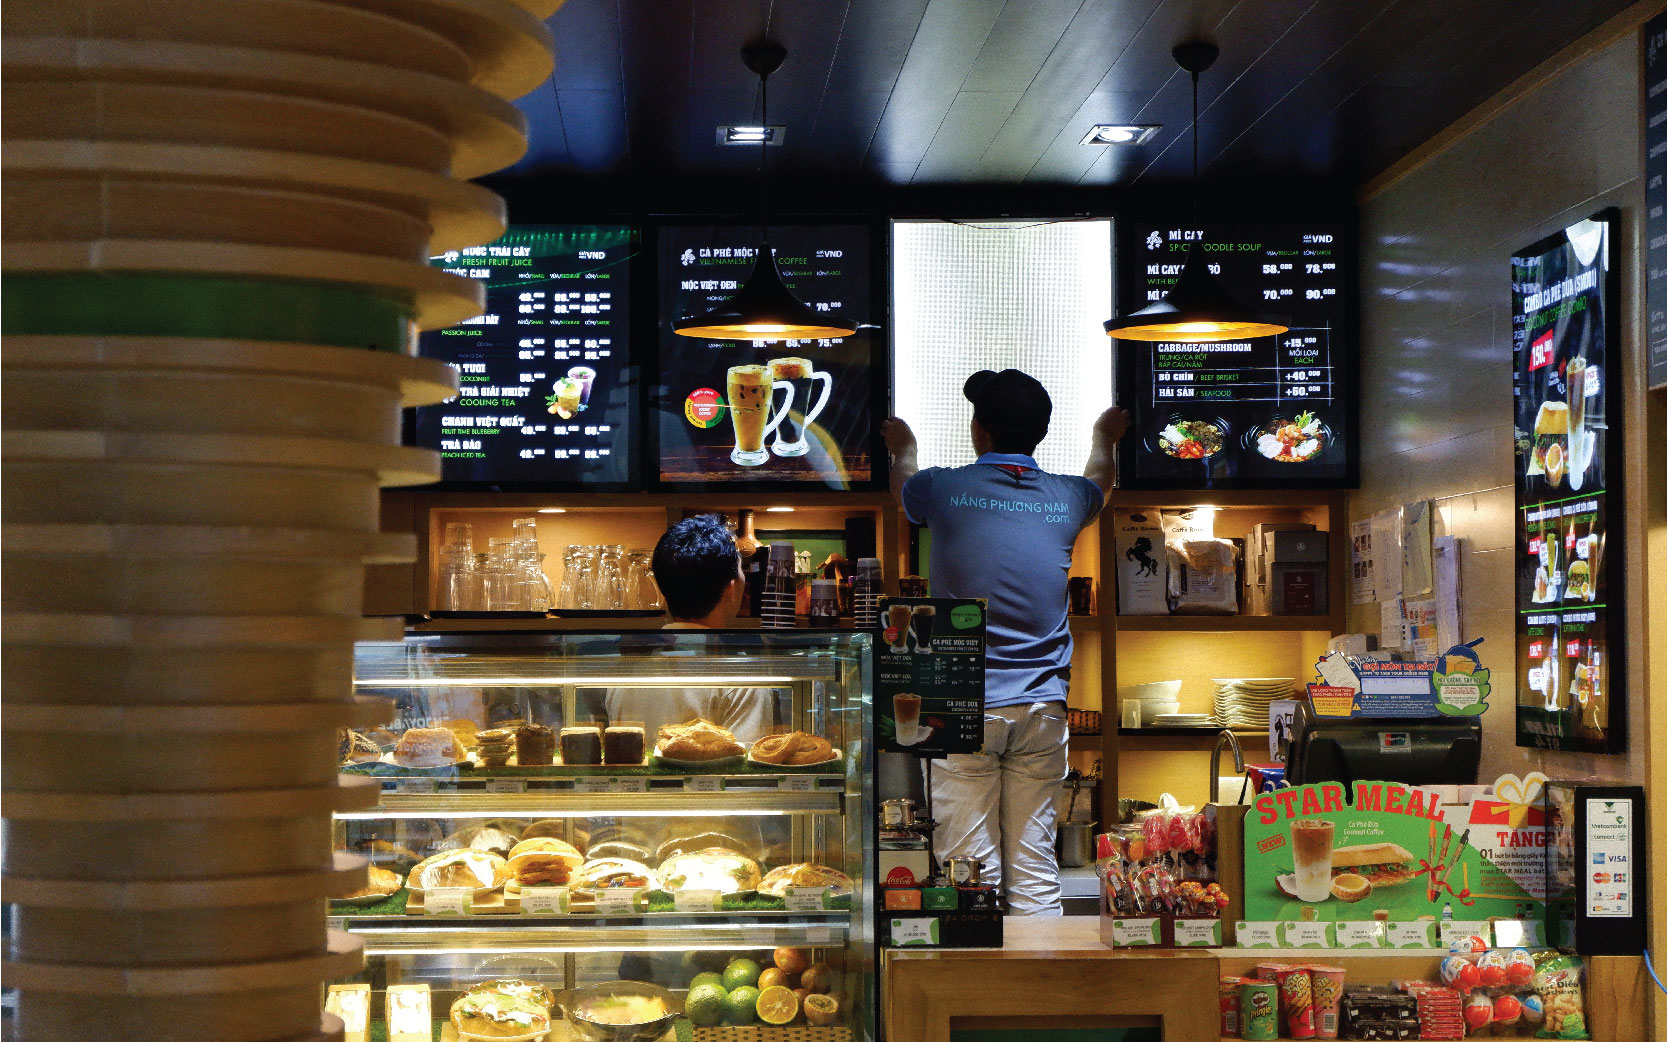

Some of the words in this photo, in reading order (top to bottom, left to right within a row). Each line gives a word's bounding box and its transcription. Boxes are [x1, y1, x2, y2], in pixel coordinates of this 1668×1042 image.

[1168, 229, 1182, 240] MÌ
[1312, 234, 1333, 243] VND
[699, 247, 711, 257] CÀ
[713, 247, 731, 257] PHÊ
[734, 247, 753, 259] MỘC
[1202, 243, 1234, 252] OODLE
[1237, 243, 1262, 252] SOUP
[586, 251, 606, 260] VND
[824, 250, 843, 258] VND
[510, 259, 532, 267] JUICE
[778, 257, 808, 265] COFFEE
[469, 268, 490, 278] CAM
[1147, 263, 1160, 275] MÌ
[1161, 264, 1180, 275] CAY
[1262, 263, 1293, 274] 58.000
[1305, 263, 1336, 274] 78.000
[681, 280, 699, 291] MỘC
[700, 280, 719, 291] VIỆT
[720, 280, 737, 290] ĐEN
[1147, 288, 1160, 301] MÌ
[1263, 289, 1293, 300] 70.000
[1305, 288, 1336, 300] 90.000
[816, 301, 842, 311] 70.000
[1524, 291, 1543, 314] COMBO
[1524, 310, 1549, 332] COCONUT
[1549, 303, 1567, 322] COFFEE
[1567, 295, 1587, 315] COMBO
[1157, 343, 1252, 353] CABBAGE/MUSHROOM
[1283, 337, 1317, 348] +15.000
[1285, 370, 1321, 381] +40.000
[1158, 386, 1175, 397] HẢI
[1176, 386, 1195, 397] SẢN
[1285, 385, 1321, 396] +50.000
[441, 417, 474, 426] CHANH
[475, 415, 499, 427] VIỆT
[440, 439, 461, 450] TRÀ
[949, 492, 987, 509] NẮNG
[990, 499, 1042, 513] PHƯƠNG
[1044, 502, 1070, 513] NAM
[1043, 514, 1070, 523] .com
[1256, 785, 1344, 825] STAR
[1355, 783, 1446, 822] MEAL
[1261, 837, 1283, 850] NEW
[1496, 828, 1546, 850] TẶNG
[1480, 848, 1493, 859] 01
[1608, 855, 1627, 863] VISA
